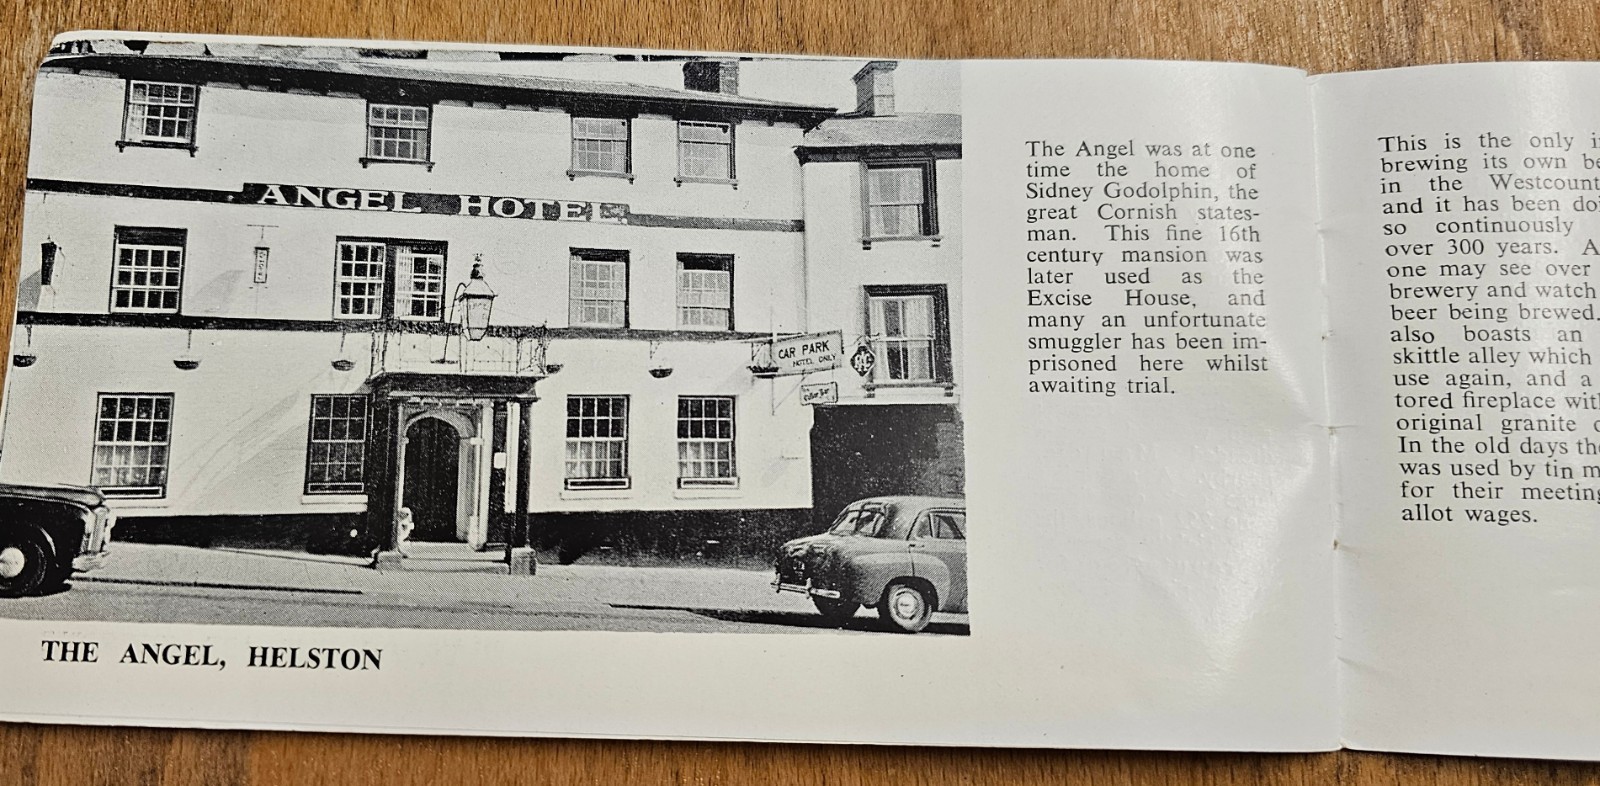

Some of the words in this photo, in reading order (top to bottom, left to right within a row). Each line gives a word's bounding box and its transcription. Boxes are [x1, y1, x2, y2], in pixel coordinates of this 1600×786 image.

[1025, 140, 1065, 157] The
[1075, 140, 1134, 159] Angel
[1145, 145, 1182, 156] was
[1192, 143, 1211, 156] at
[1221, 146, 1256, 158] one
[1377, 135, 1427, 152] This
[1444, 133, 1461, 149] is
[1478, 132, 1511, 148] the
[1530, 132, 1573, 151] only
[1026, 161, 1071, 177] time
[1097, 161, 1128, 177] the
[1155, 161, 1209, 177] home
[1237, 163, 1256, 179] of
[1380, 154, 1468, 173] brewing
[1483, 153, 1507, 169] its
[1524, 157, 1566, 168] own
[1026, 182, 1093, 202] Sidney
[1104, 182, 1218, 202] Godolphin,
[1229, 183, 1258, 200] the
[1380, 178, 1402, 194] in
[1428, 175, 1463, 191] the
[256, 184, 422, 213] ANGEL
[459, 195, 628, 225] HOTEL
[1027, 205, 1078, 223] great
[1097, 203, 1177, 220] Cornish
[1198, 206, 1259, 221] states-
[1382, 197, 1423, 214] and
[1435, 196, 1451, 212] it
[1463, 195, 1499, 211] has
[1511, 195, 1560, 211] been
[1027, 229, 1076, 241] man.
[1104, 224, 1149, 241] This
[1166, 224, 1202, 241] fine
[1220, 225, 1260, 242] 16th
[1383, 224, 1407, 235] so
[1436, 216, 1573, 236] continuously
[1027, 248, 1103, 266] century
[1121, 246, 1207, 262] mansion
[1226, 251, 1263, 263] was
[1385, 244, 1434, 256] over
[1447, 239, 1484, 255] 300
[1496, 242, 1558, 258] years.
[1027, 267, 1073, 284] later
[1104, 267, 1151, 284] used
[1182, 272, 1202, 284] as
[1233, 268, 1263, 284] the
[1386, 265, 1427, 277] one
[1439, 264, 1486, 279] may
[1500, 264, 1531, 276] see
[1546, 264, 1590, 276] over
[1027, 289, 1092, 306] Excise
[1124, 289, 1196, 308] House,
[1228, 289, 1266, 306] and
[1388, 283, 1478, 301] brewery
[1487, 281, 1527, 298] and
[1535, 282, 1597, 298] watch
[1028, 315, 1085, 331] many
[1102, 315, 1126, 327] an
[1144, 310, 1265, 327] unfortunate
[1390, 304, 1437, 321] beer
[1448, 303, 1508, 323] being
[1518, 303, 1600, 321] brewed.
[1028, 332, 1122, 353] smuggler
[1131, 332, 1165, 349] has
[1175, 333, 1223, 349] been
[1233, 332, 1267, 349] im-
[1390, 325, 1435, 344] also
[1463, 325, 1531, 341] boasts
[1558, 330, 1583, 342] an
[778, 346, 796, 359] CAR
[802, 340, 829, 355] PARK
[1393, 346, 1460, 364] skittle
[1469, 346, 1521, 367] alley
[1528, 347, 1592, 365] which
[1028, 355, 1117, 375] prisoned
[1139, 354, 1183, 371] here
[1206, 354, 1268, 371] whilst
[1029, 376, 1116, 397] awaiting
[1127, 376, 1175, 394] trial.
[1393, 374, 1429, 386] use
[1446, 369, 1511, 389] again,
[1527, 370, 1566, 386] and
[1581, 375, 1592, 386] a
[1394, 392, 1454, 409] tored
[1462, 390, 1555, 412] fireplace
[1564, 392, 1600, 410] wit
[1396, 413, 1482, 434] original
[1501, 414, 1576, 435] granite
[1398, 436, 1422, 453] In
[1431, 436, 1465, 453] the
[1475, 436, 1510, 454] old
[1520, 436, 1568, 458] days
[1576, 437, 1600, 455] th
[1399, 463, 1441, 475] was
[1449, 458, 1500, 476] used
[1508, 459, 1536, 480] by
[1545, 459, 1574, 479] tin
[1400, 480, 1434, 498] for
[1452, 481, 1503, 499] their
[1521, 483, 1600, 504] meetin
[1402, 503, 1453, 521] allot
[1464, 509, 1537, 526] wages.
[42, 640, 99, 663] THE
[119, 643, 226, 671] ANGEL,
[247, 646, 383, 670] HELSTON
